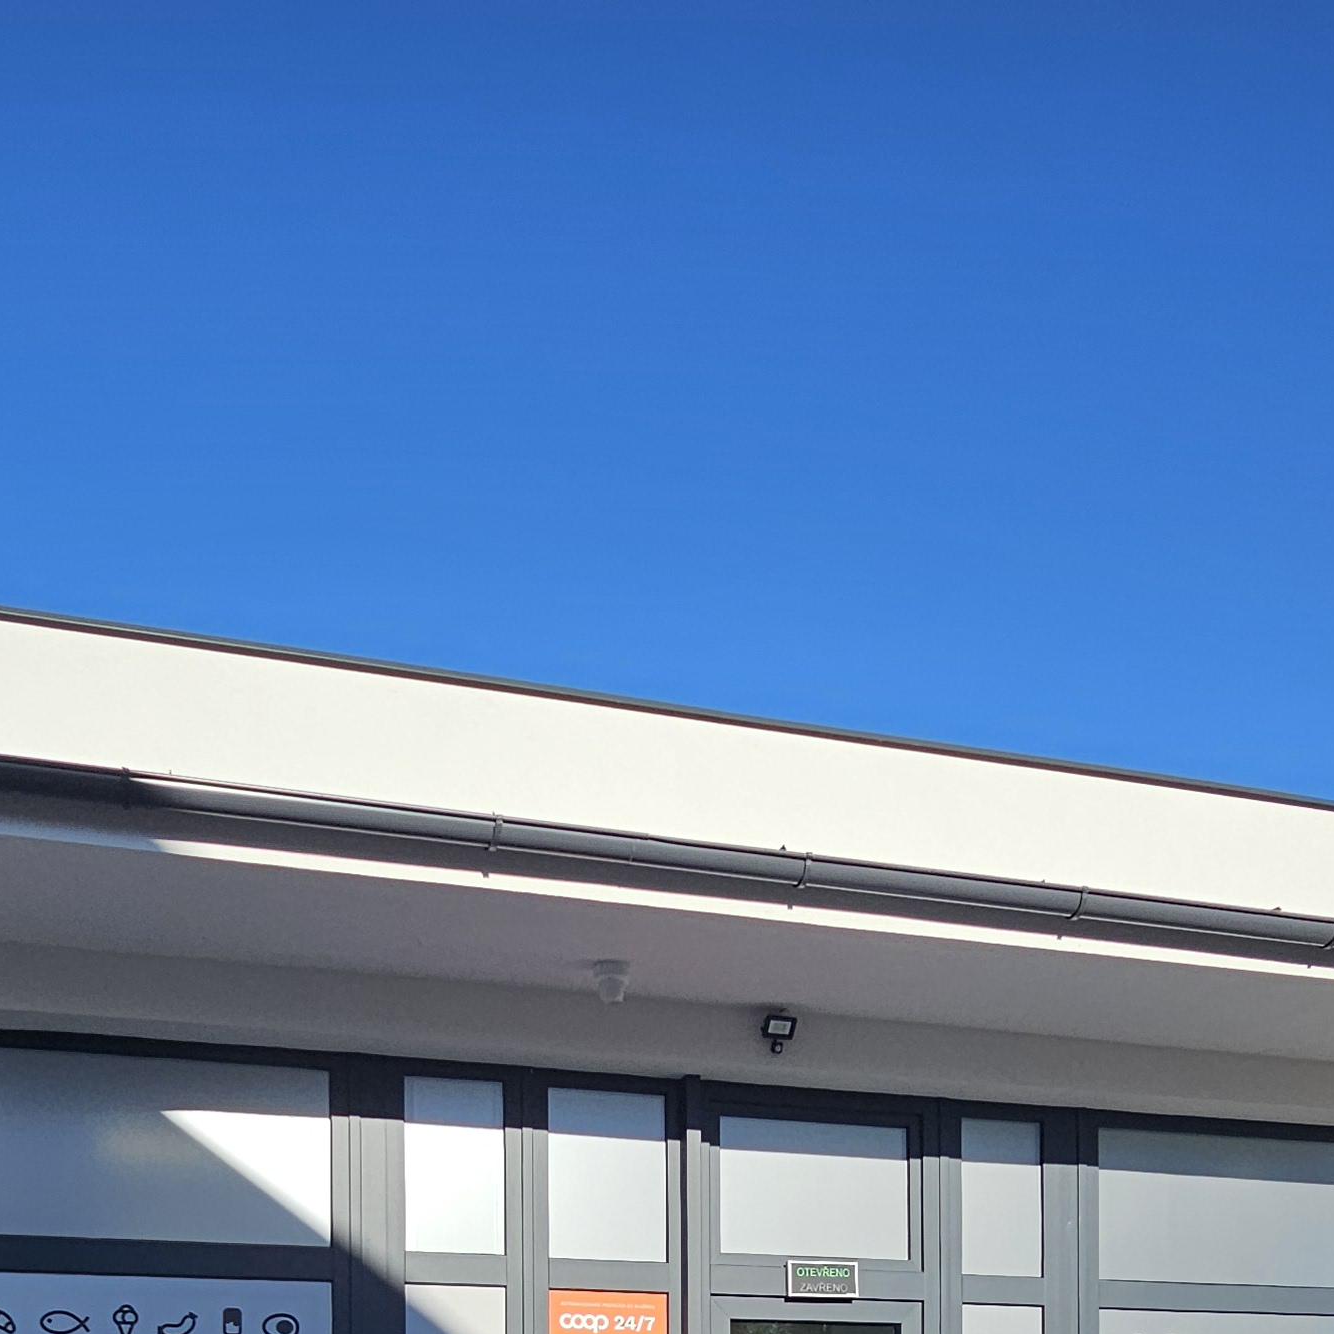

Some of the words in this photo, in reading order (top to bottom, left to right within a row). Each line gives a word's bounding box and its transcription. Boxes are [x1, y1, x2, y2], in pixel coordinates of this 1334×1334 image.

[796, 1265, 851, 1278] OTEVŘENO
[799, 1281, 849, 1293] ZAVŘENO
[559, 1313, 610, 1334] coop
[613, 1315, 656, 1333] 24/7
